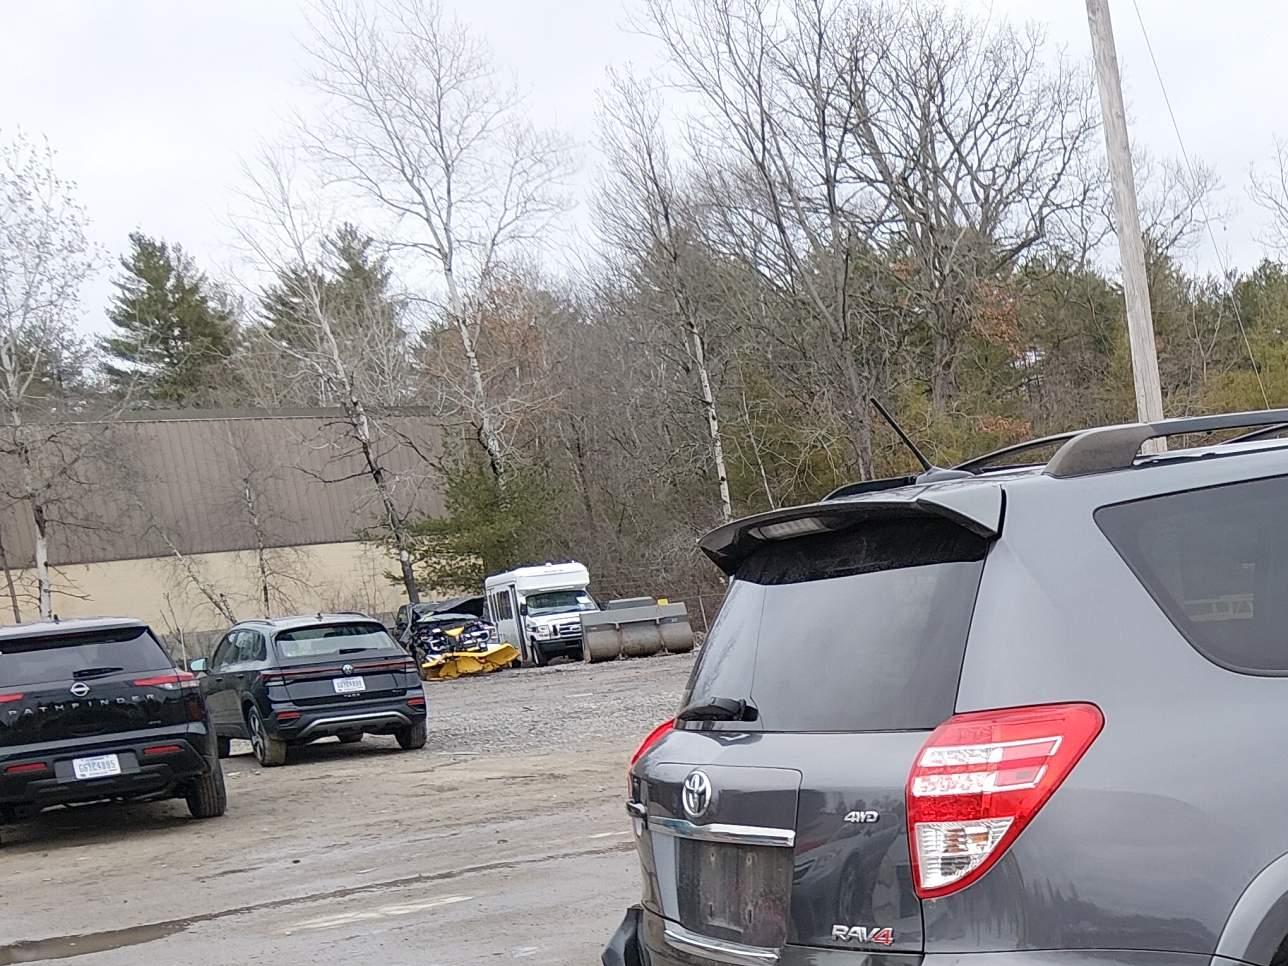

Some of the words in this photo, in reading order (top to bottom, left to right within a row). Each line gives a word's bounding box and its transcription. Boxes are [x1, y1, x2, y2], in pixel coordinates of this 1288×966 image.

[8, 694, 155, 717] PATHFINDER
[844, 810, 879, 823] 4WD
[831, 924, 894, 946] RAV4
